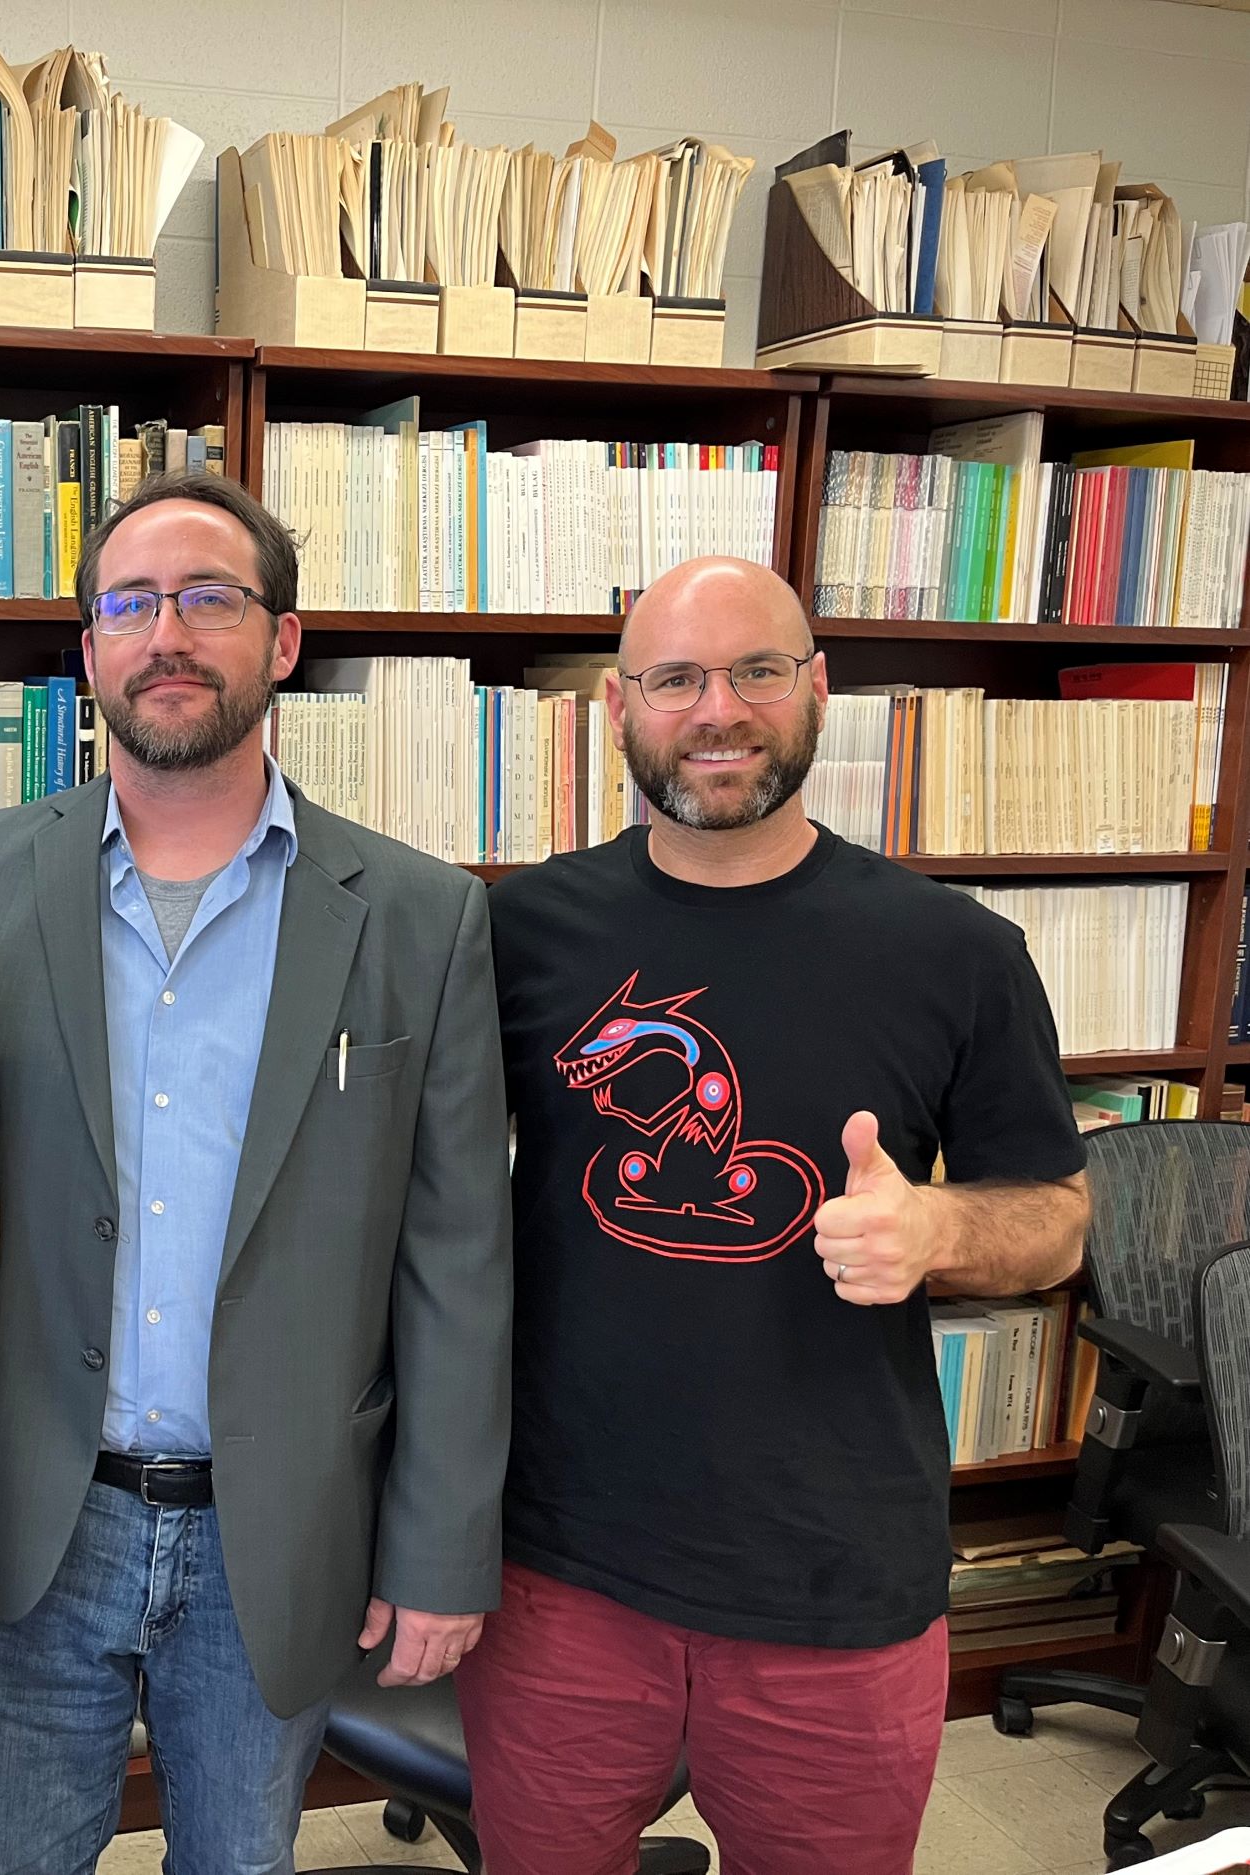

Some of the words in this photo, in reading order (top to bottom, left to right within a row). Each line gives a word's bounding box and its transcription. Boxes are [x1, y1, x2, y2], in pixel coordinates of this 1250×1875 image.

[88, 410, 96, 446] AMERICAN
[19, 461, 39, 470] English
[68, 497, 79, 527] English
[68, 528, 78, 569] Language
[56, 688, 66, 703] A
[56, 704, 67, 746] Structural
[5, 747, 14, 774] English
[54, 747, 66, 777] History
[55, 778, 67, 787] of
[1029, 1328, 1038, 1359] SECOND
[1024, 1387, 1032, 1413] FORUM
